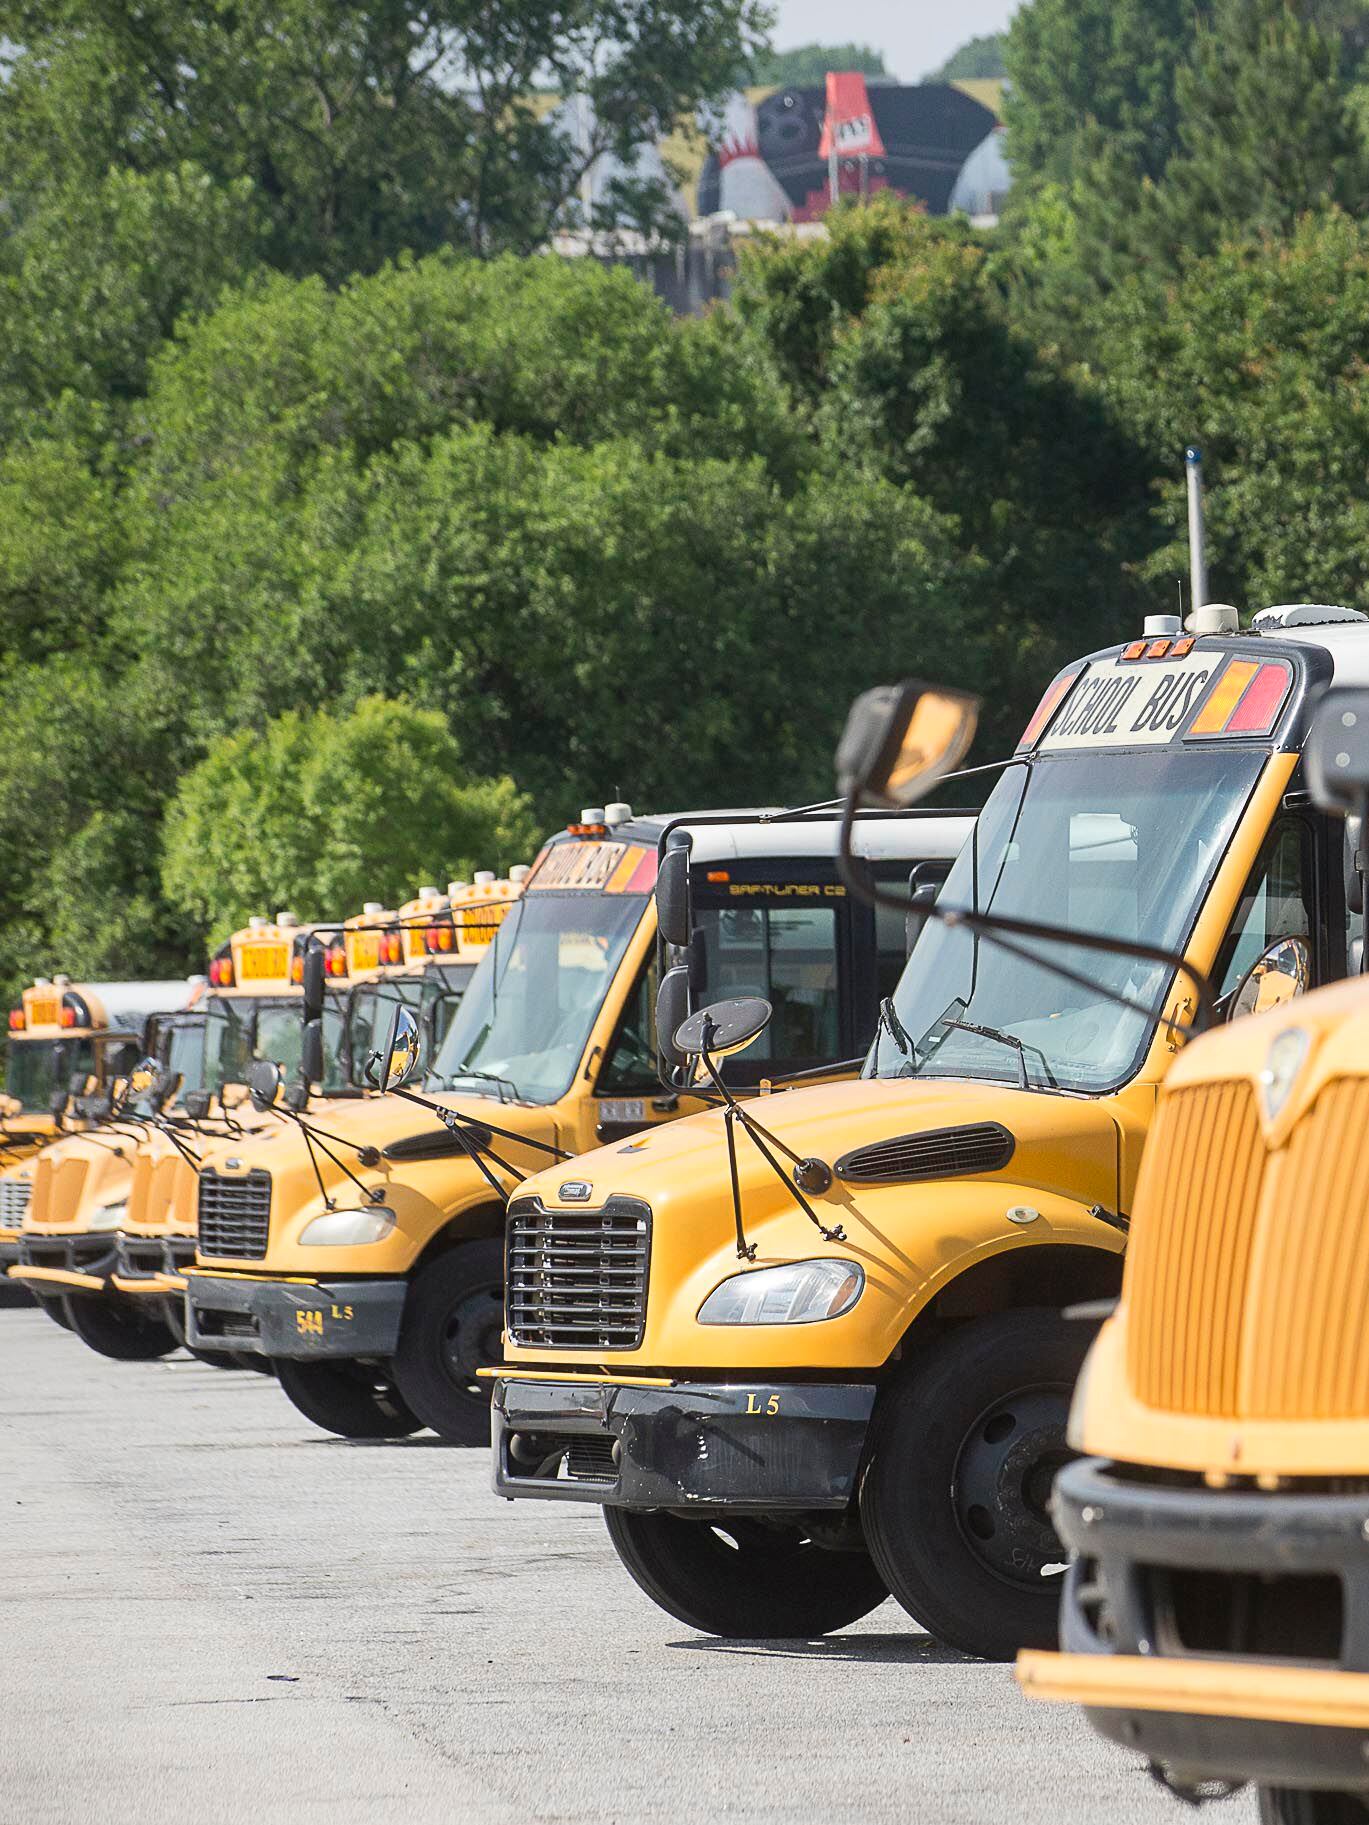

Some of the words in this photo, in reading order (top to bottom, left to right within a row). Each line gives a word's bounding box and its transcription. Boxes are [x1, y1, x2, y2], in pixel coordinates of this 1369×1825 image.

[1052, 675, 1142, 737] SCHOOL
[1130, 669, 1209, 732] BUS
[296, 1310, 323, 1335] 544
